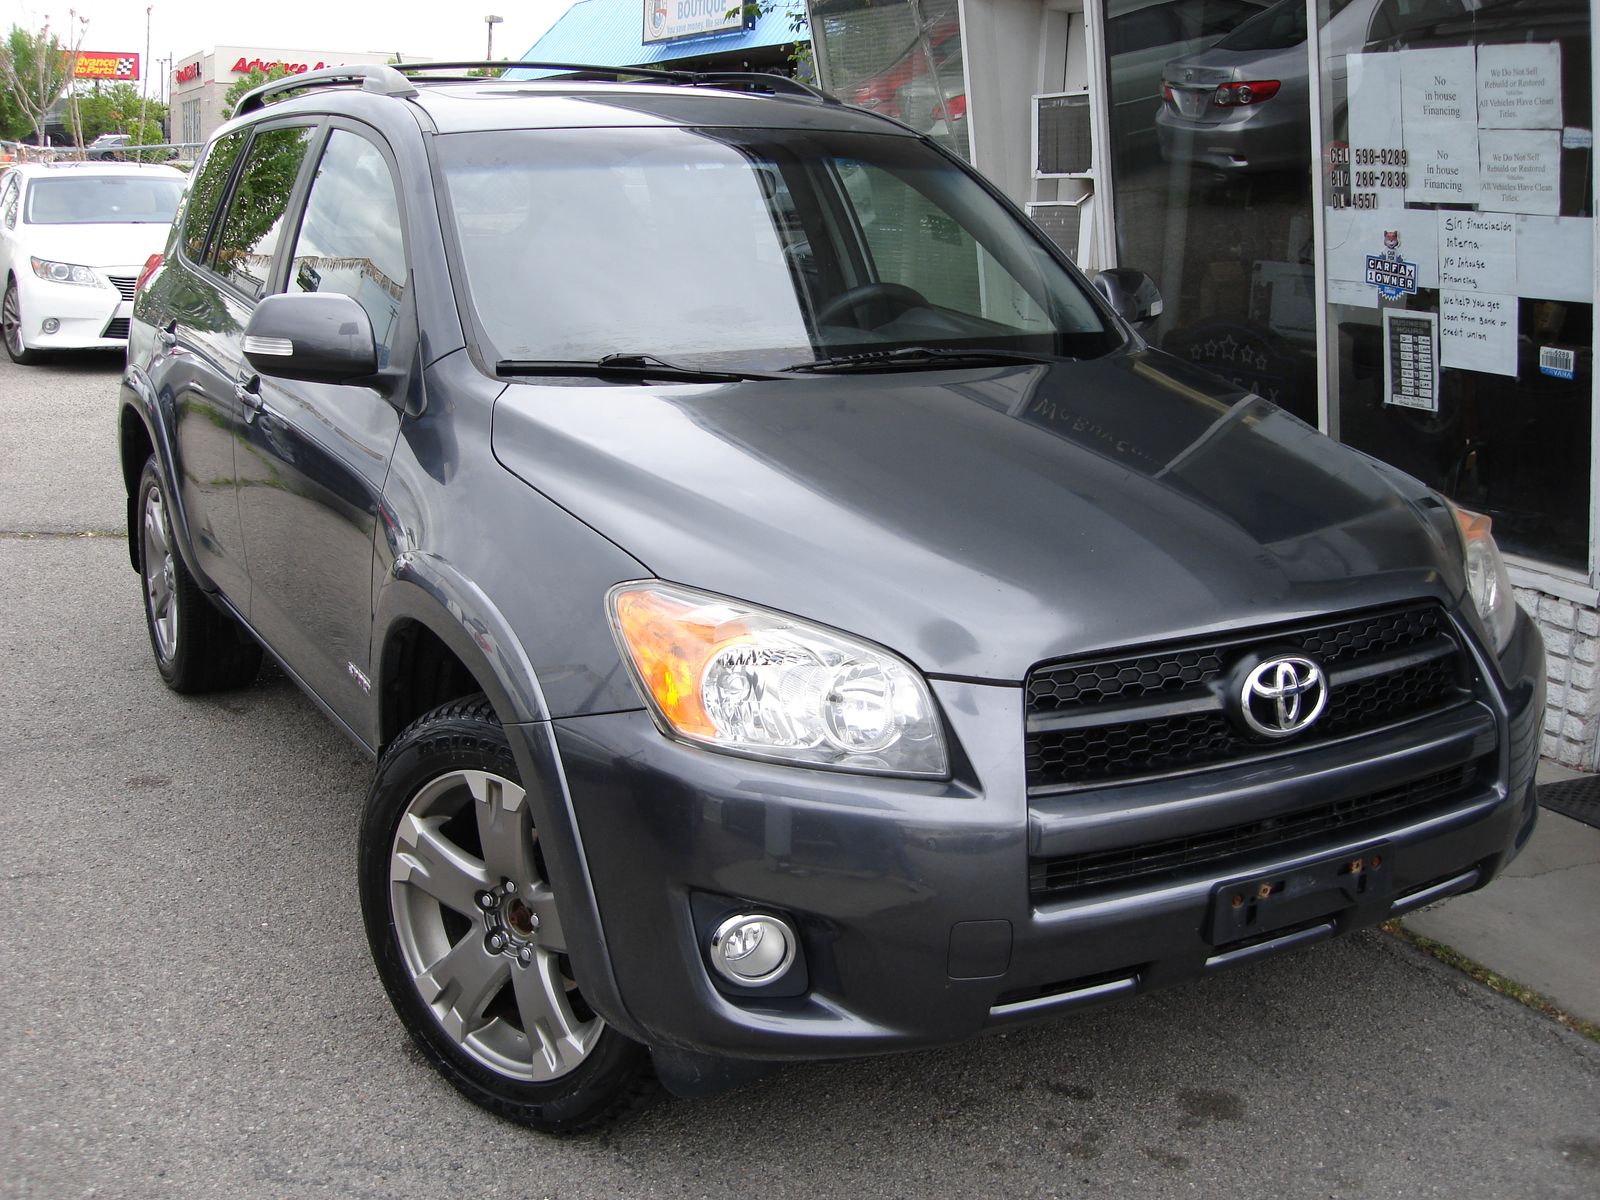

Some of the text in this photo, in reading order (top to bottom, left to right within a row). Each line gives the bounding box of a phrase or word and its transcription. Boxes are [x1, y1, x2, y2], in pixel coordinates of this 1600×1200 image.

[678, 0, 727, 19] BOUTIQUE
[77, 57, 115, 67] dvance
[86, 66, 114, 74] Parts
[1490, 66, 1538, 77] We Do Not Sell
[1434, 76, 1446, 86] No
[1518, 78, 1545, 87] Restored
[1425, 90, 1457, 101] in house
[1479, 97, 1554, 108] All Vehicles Have Clean
[1423, 105, 1461, 119] Financing
[1330, 148, 1407, 165] CEL 598-9289
[1436, 150, 1449, 160] No
[1492, 153, 1540, 161] We Do Not Sell
[1426, 163, 1459, 175] in house
[1356, 171, 1407, 187] 288-2838
[1424, 179, 1462, 192] Financing
[1482, 183, 1553, 191] All Vehicles Have Clean
[1352, 193, 1376, 209] 4557
[1445, 217, 1462, 231] Sin
[1368, 259, 1414, 278] CARFAX
[1443, 272, 1477, 288] Financing
[1455, 294, 1470, 307] help
[1487, 301, 1500, 312] get
[1460, 312, 1476, 321] from
[1467, 331, 1486, 341] union
